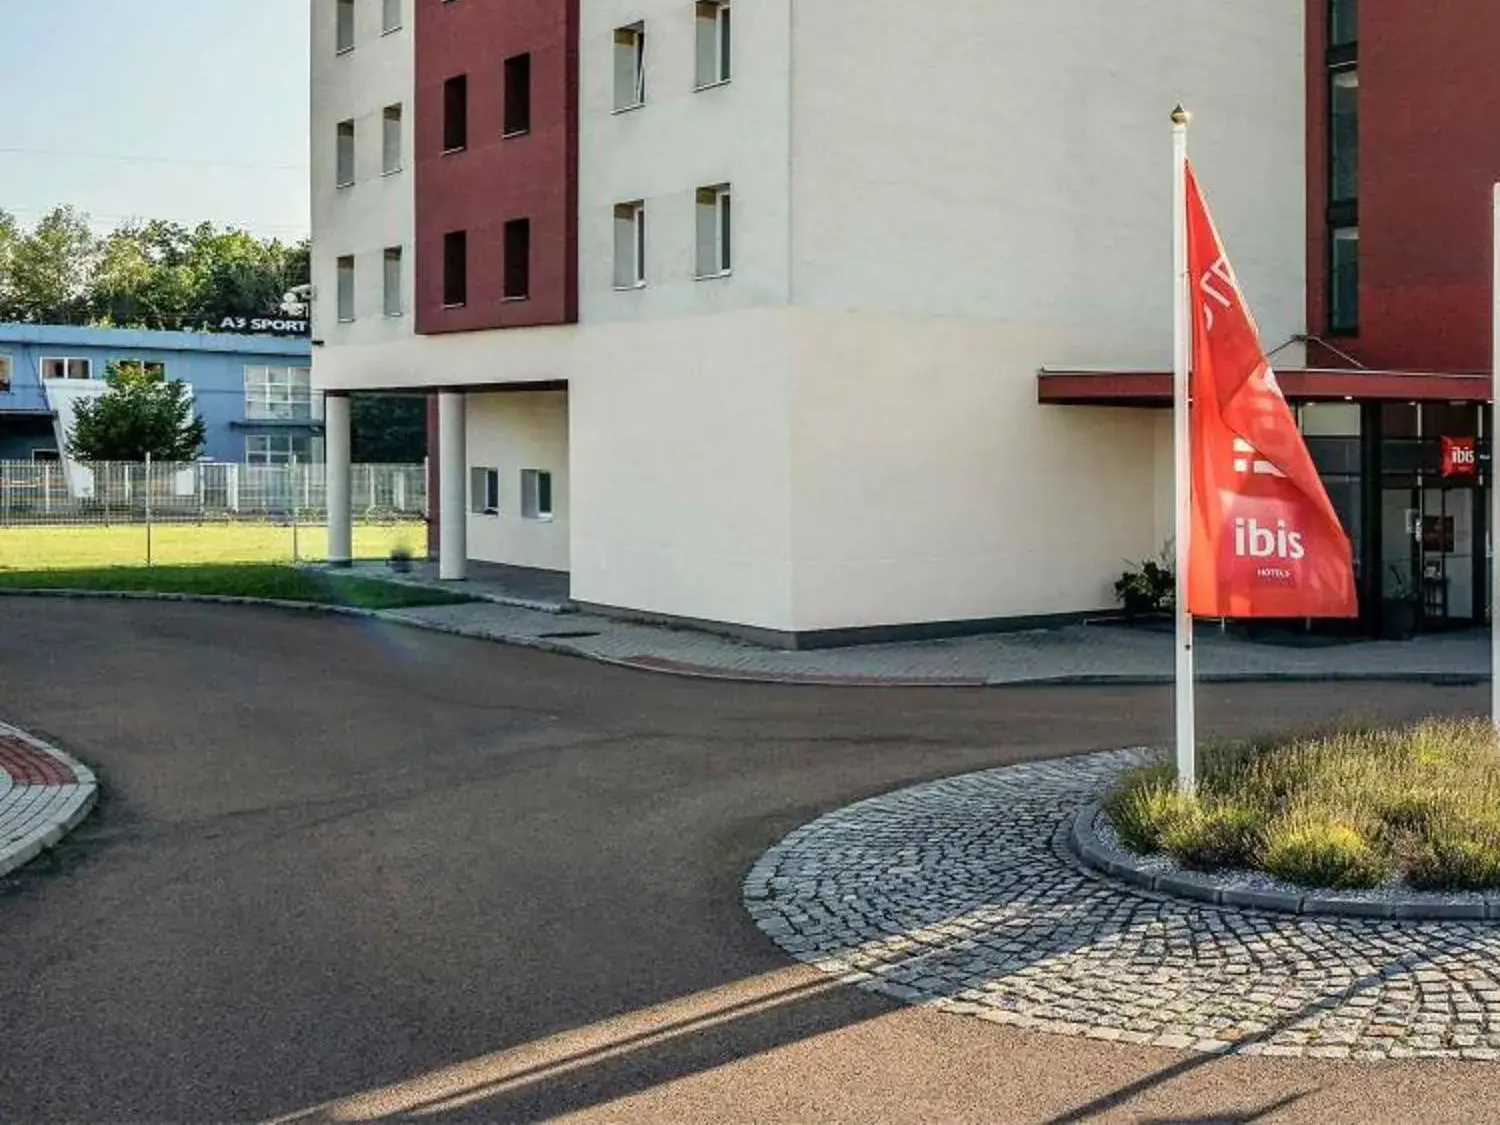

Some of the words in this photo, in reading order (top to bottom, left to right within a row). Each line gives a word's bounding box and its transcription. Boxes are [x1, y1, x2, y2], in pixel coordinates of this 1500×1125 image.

[250, 317, 308, 332] SPORT
[1451, 445, 1475, 464] ibis
[1234, 516, 1306, 559] ibis
